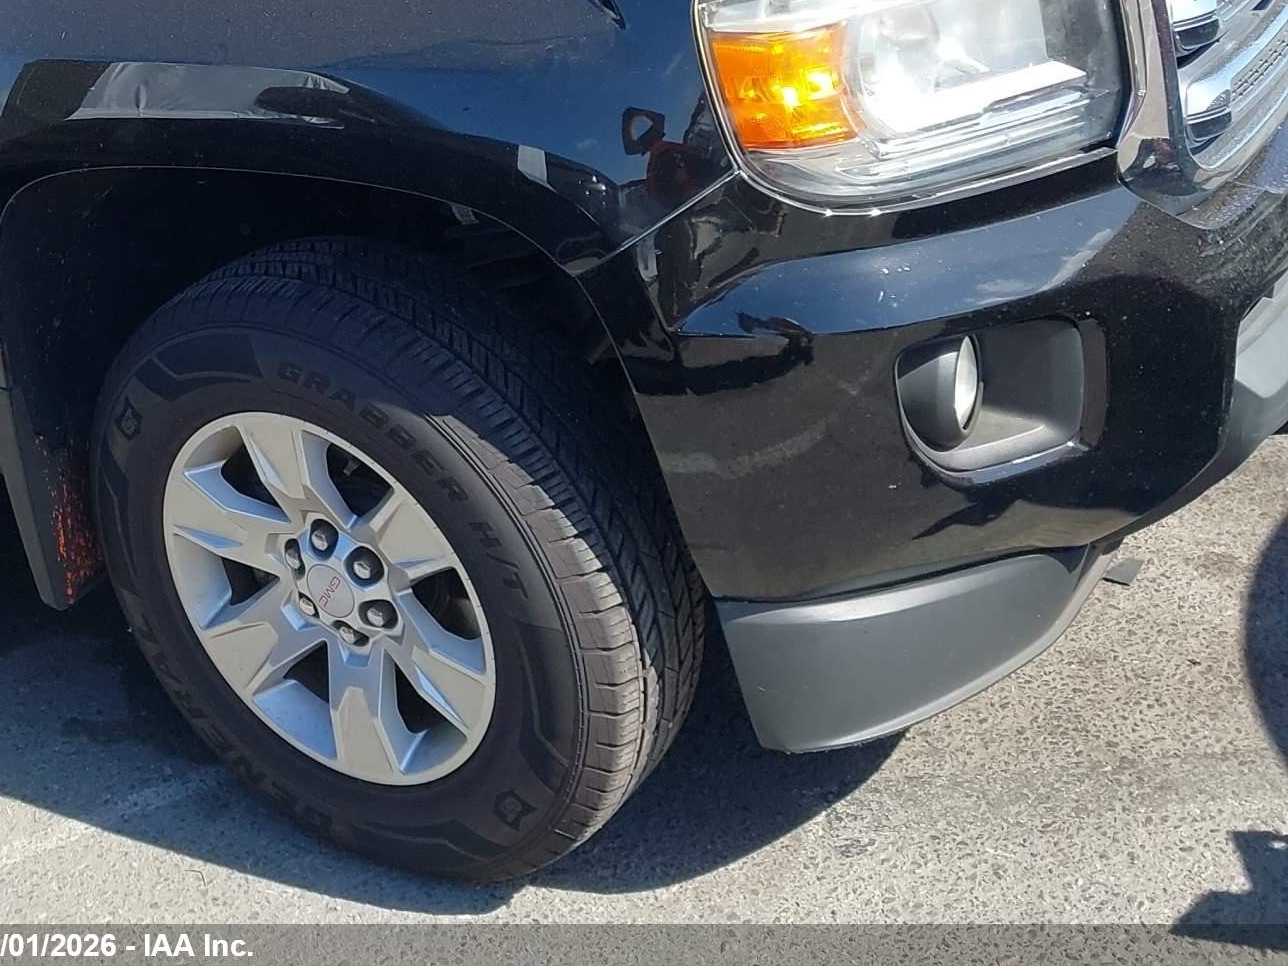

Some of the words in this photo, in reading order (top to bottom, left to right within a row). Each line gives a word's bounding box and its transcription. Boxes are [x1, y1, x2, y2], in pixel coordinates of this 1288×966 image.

[277, 360, 469, 502] GRABBER
[467, 520, 530, 600] H/T
[318, 575, 342, 609] GMC
